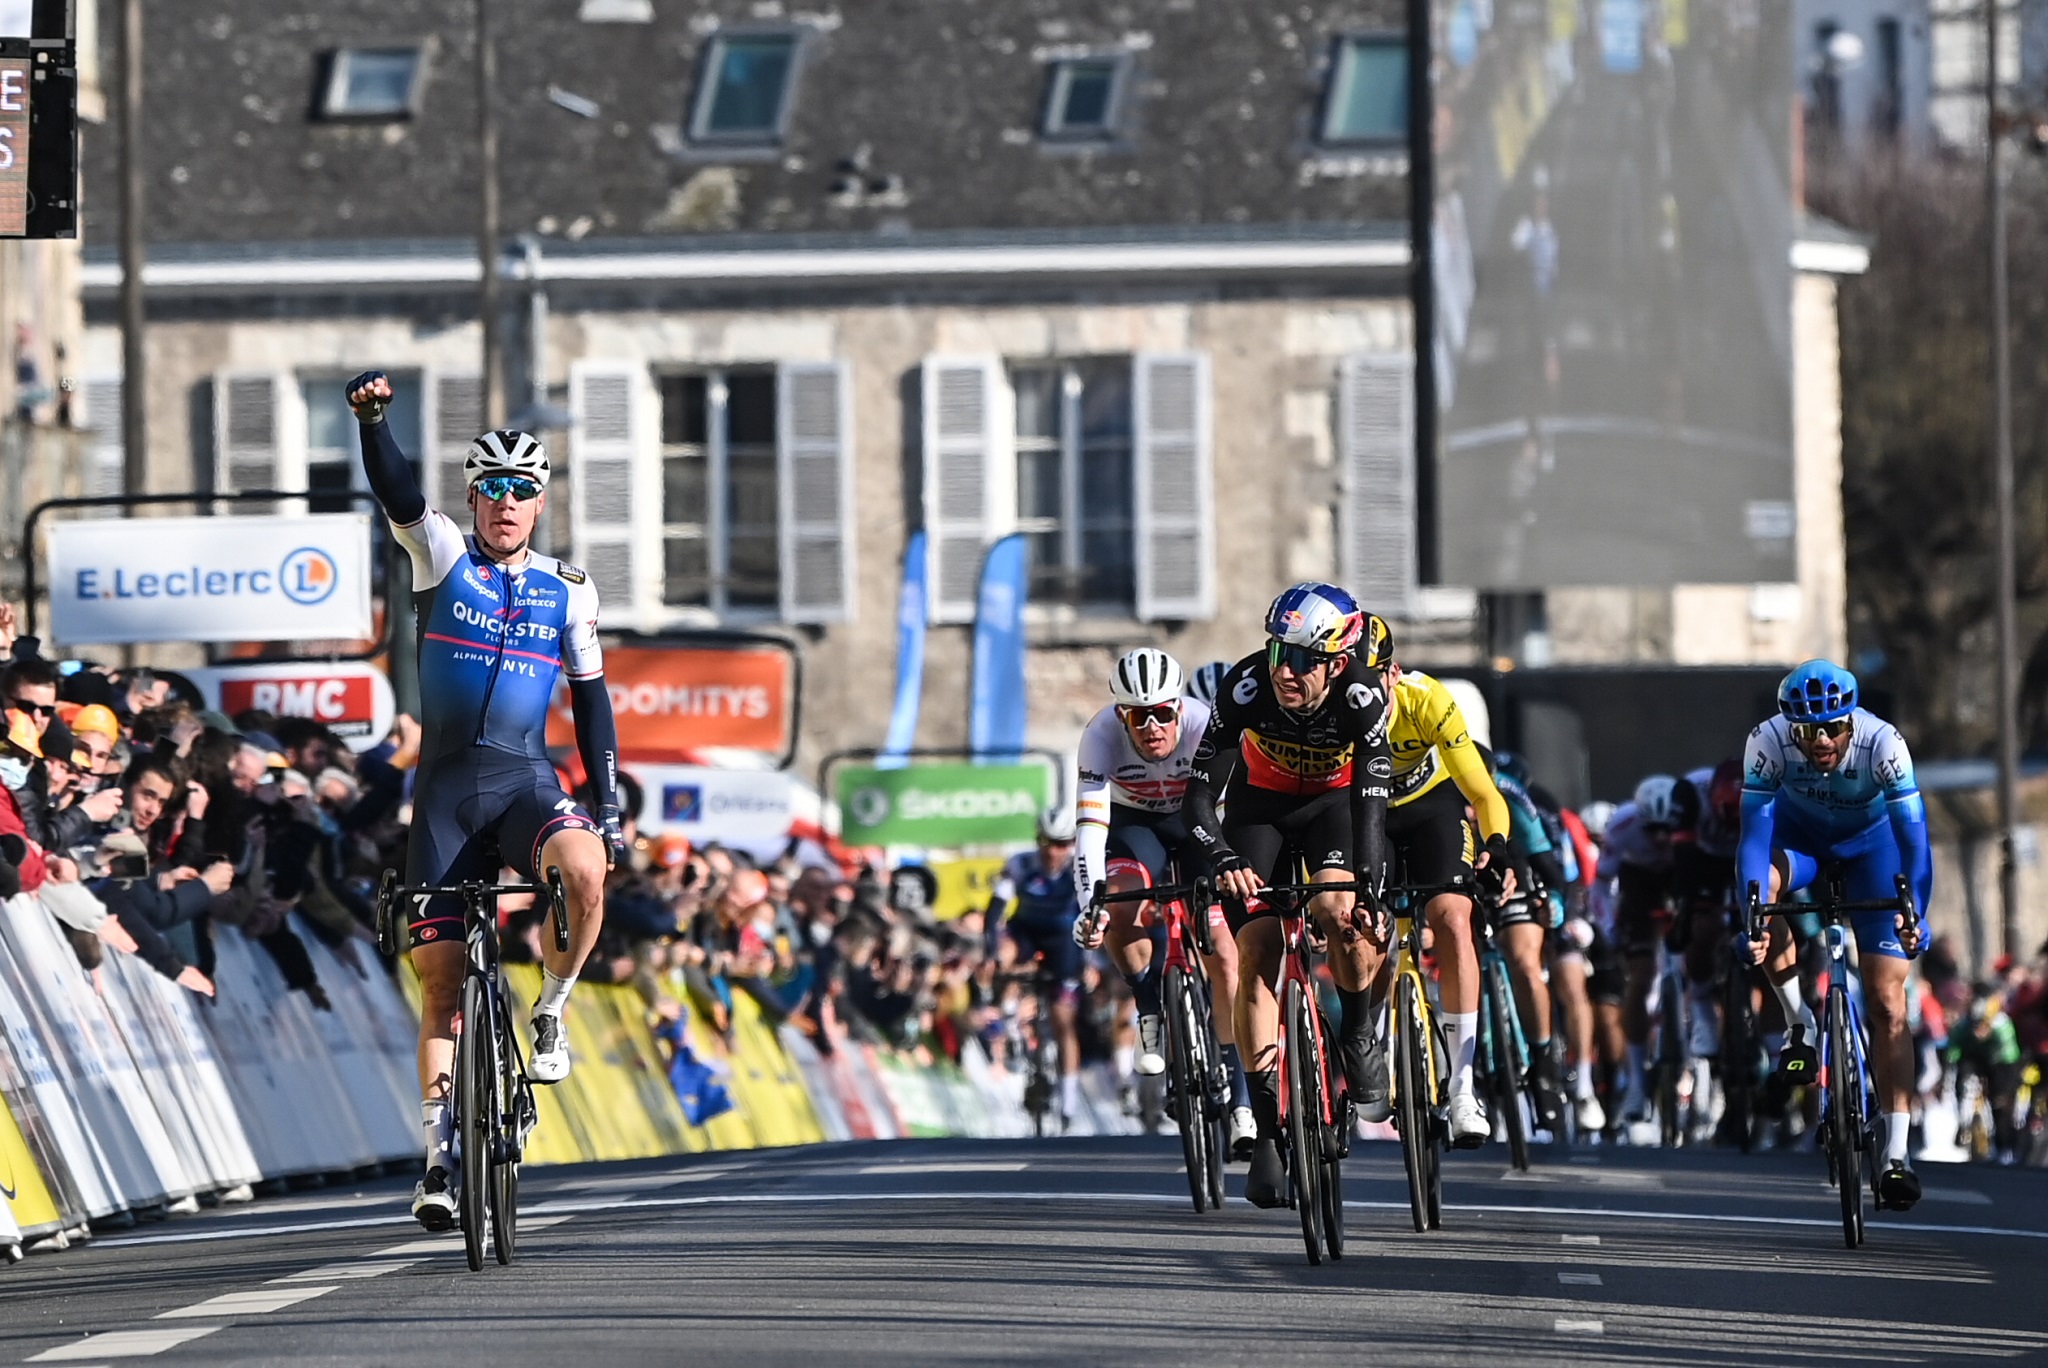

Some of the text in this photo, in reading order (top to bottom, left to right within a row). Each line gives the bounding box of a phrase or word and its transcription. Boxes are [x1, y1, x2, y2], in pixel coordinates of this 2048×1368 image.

[76, 566, 272, 600] E.Leclerc
[463, 569, 500, 602] Ekopak
[514, 597, 557, 608] latexco
[253, 681, 348, 719] RMC
[1362, 786, 1388, 799] HEM
[1078, 854, 1091, 893] TREK
